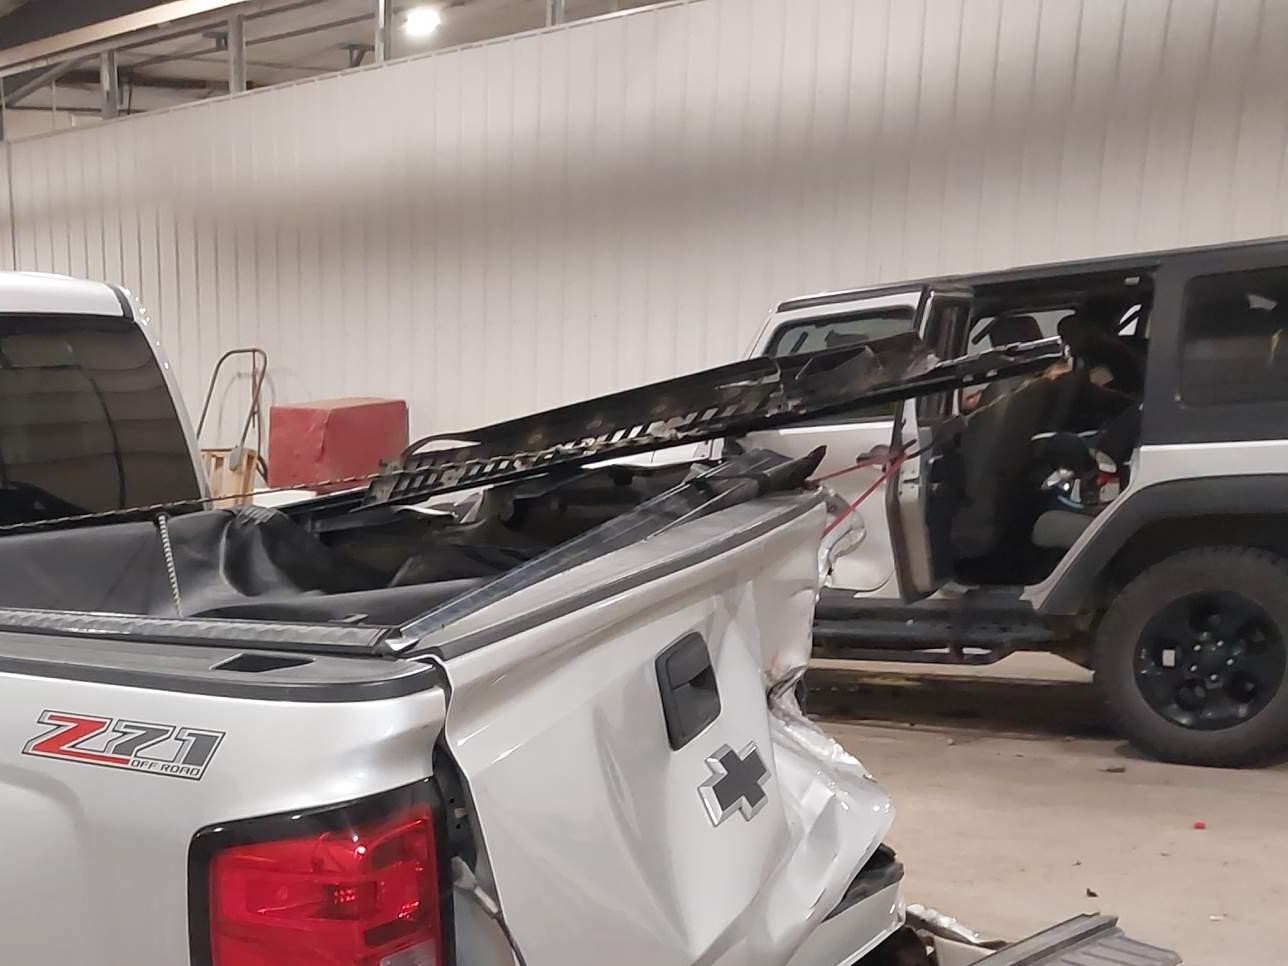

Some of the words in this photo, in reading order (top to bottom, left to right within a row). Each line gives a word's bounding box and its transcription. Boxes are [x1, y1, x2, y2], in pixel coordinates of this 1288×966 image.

[22, 709, 226, 768] Z71
[131, 759, 159, 770] OFF
[160, 763, 201, 777] ROAD
